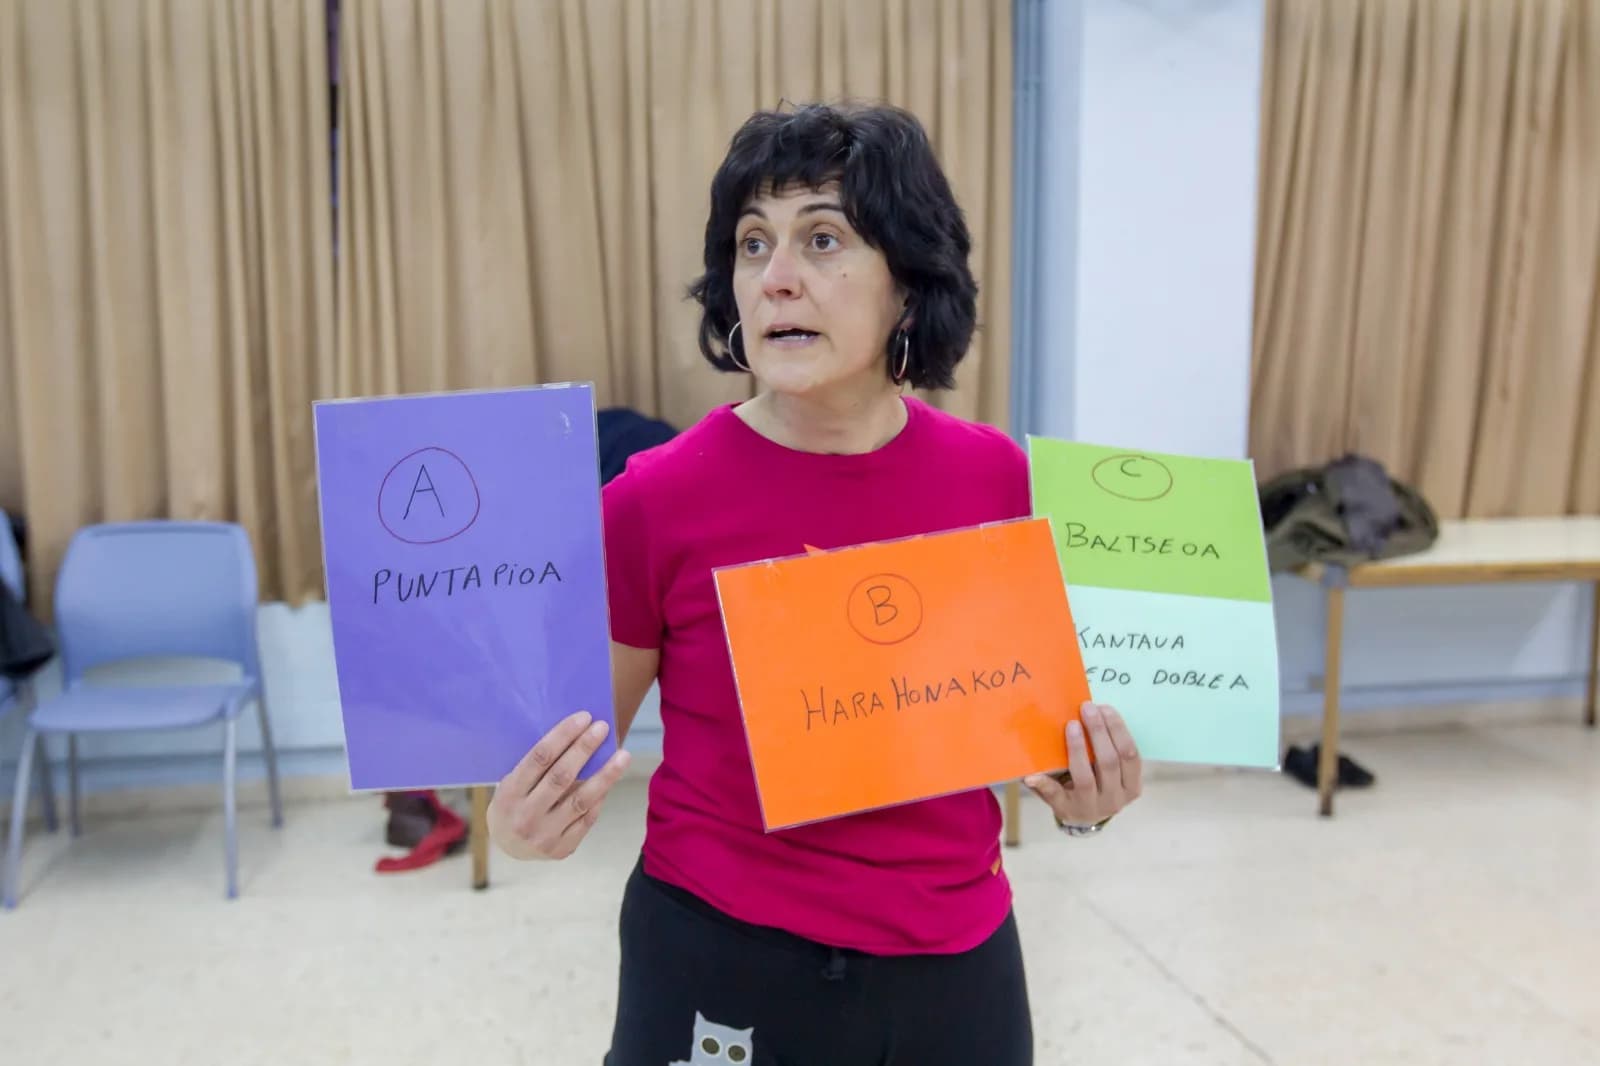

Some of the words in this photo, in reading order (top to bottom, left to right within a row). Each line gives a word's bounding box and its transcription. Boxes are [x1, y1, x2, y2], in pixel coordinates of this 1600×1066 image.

[1119, 458, 1143, 477] C
[403, 464, 445, 521] A
[866, 585, 899, 625] B
